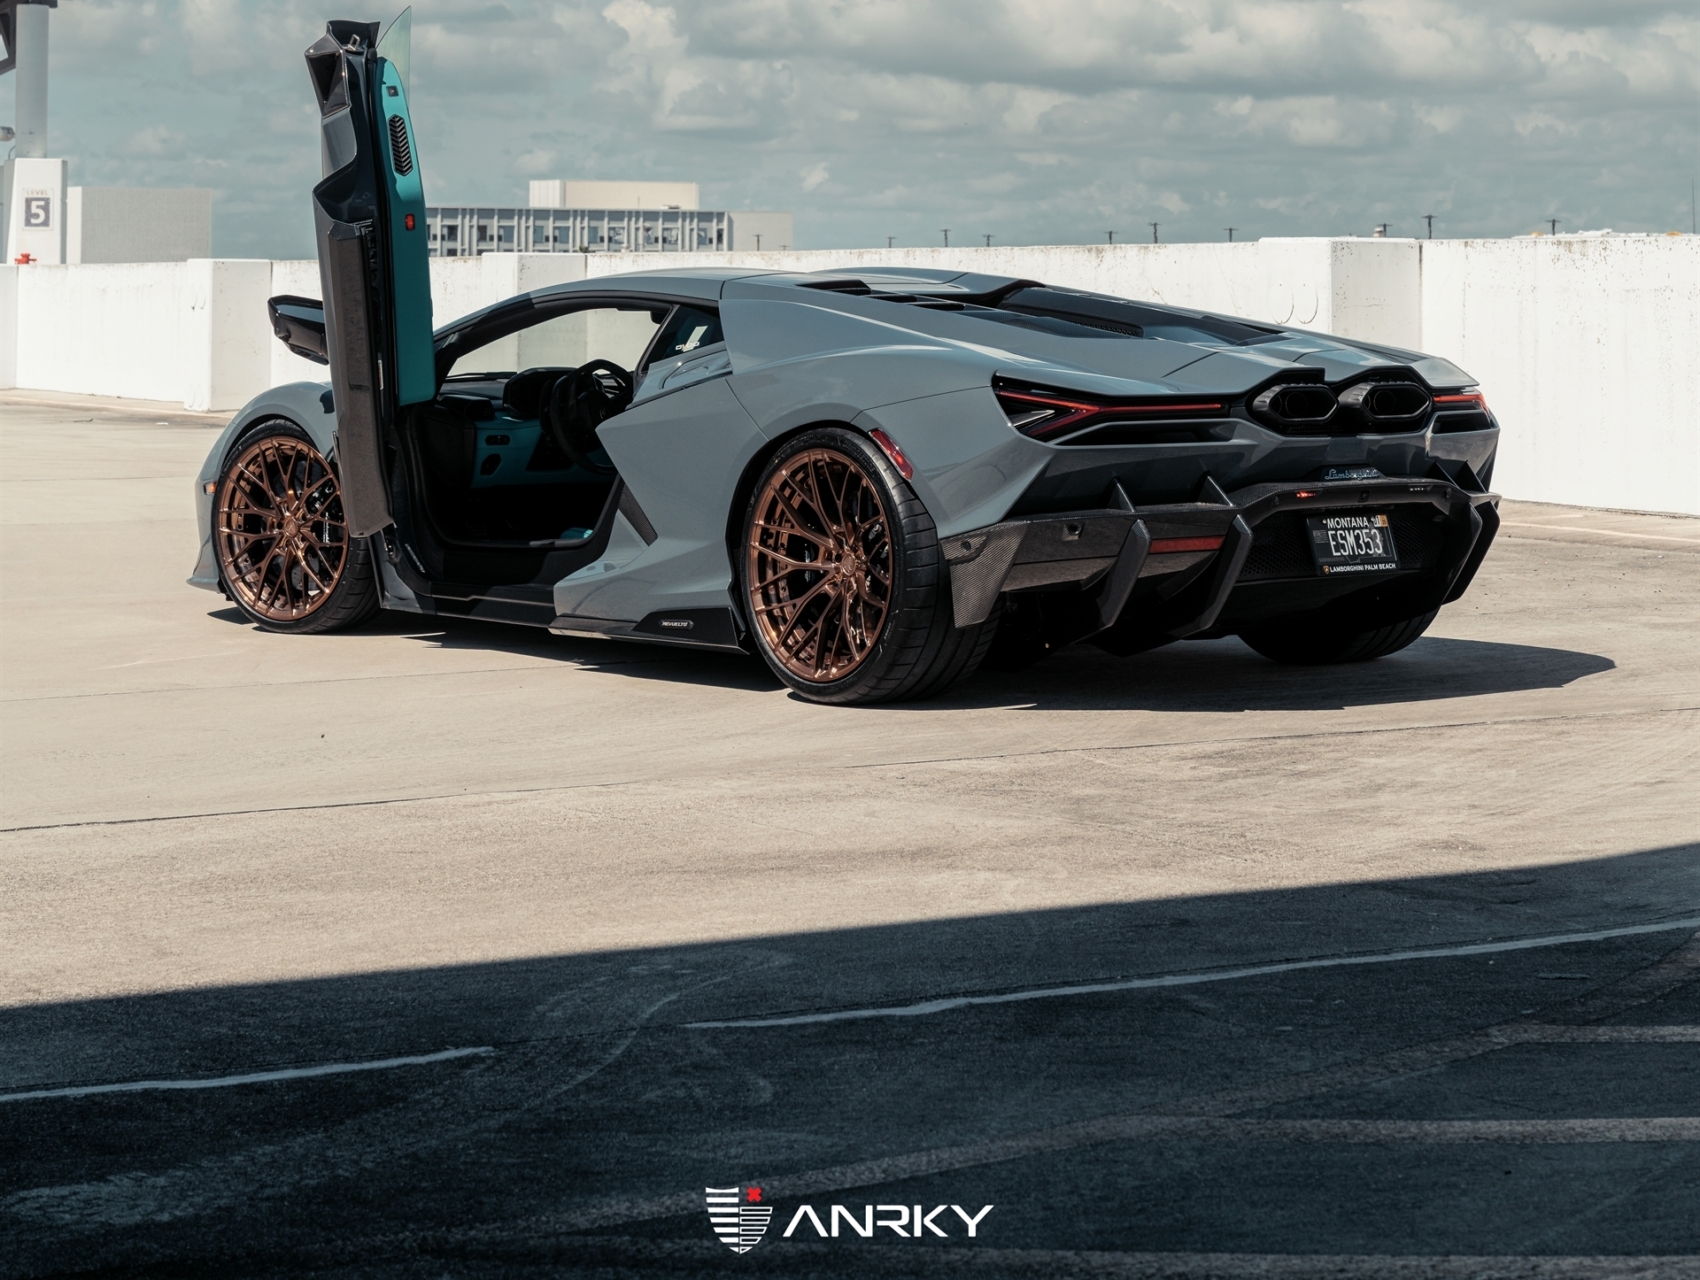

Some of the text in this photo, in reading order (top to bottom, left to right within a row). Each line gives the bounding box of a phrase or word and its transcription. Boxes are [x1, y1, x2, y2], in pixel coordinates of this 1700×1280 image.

[30, 200, 46, 224] 5
[1324, 468, 1380, 481] Lamborghini
[1327, 516, 1370, 529] MONTANA
[1327, 528, 1383, 556] ESM353
[1329, 565, 1364, 573] LAMBORGHINI
[1378, 562, 1396, 570] BEACH
